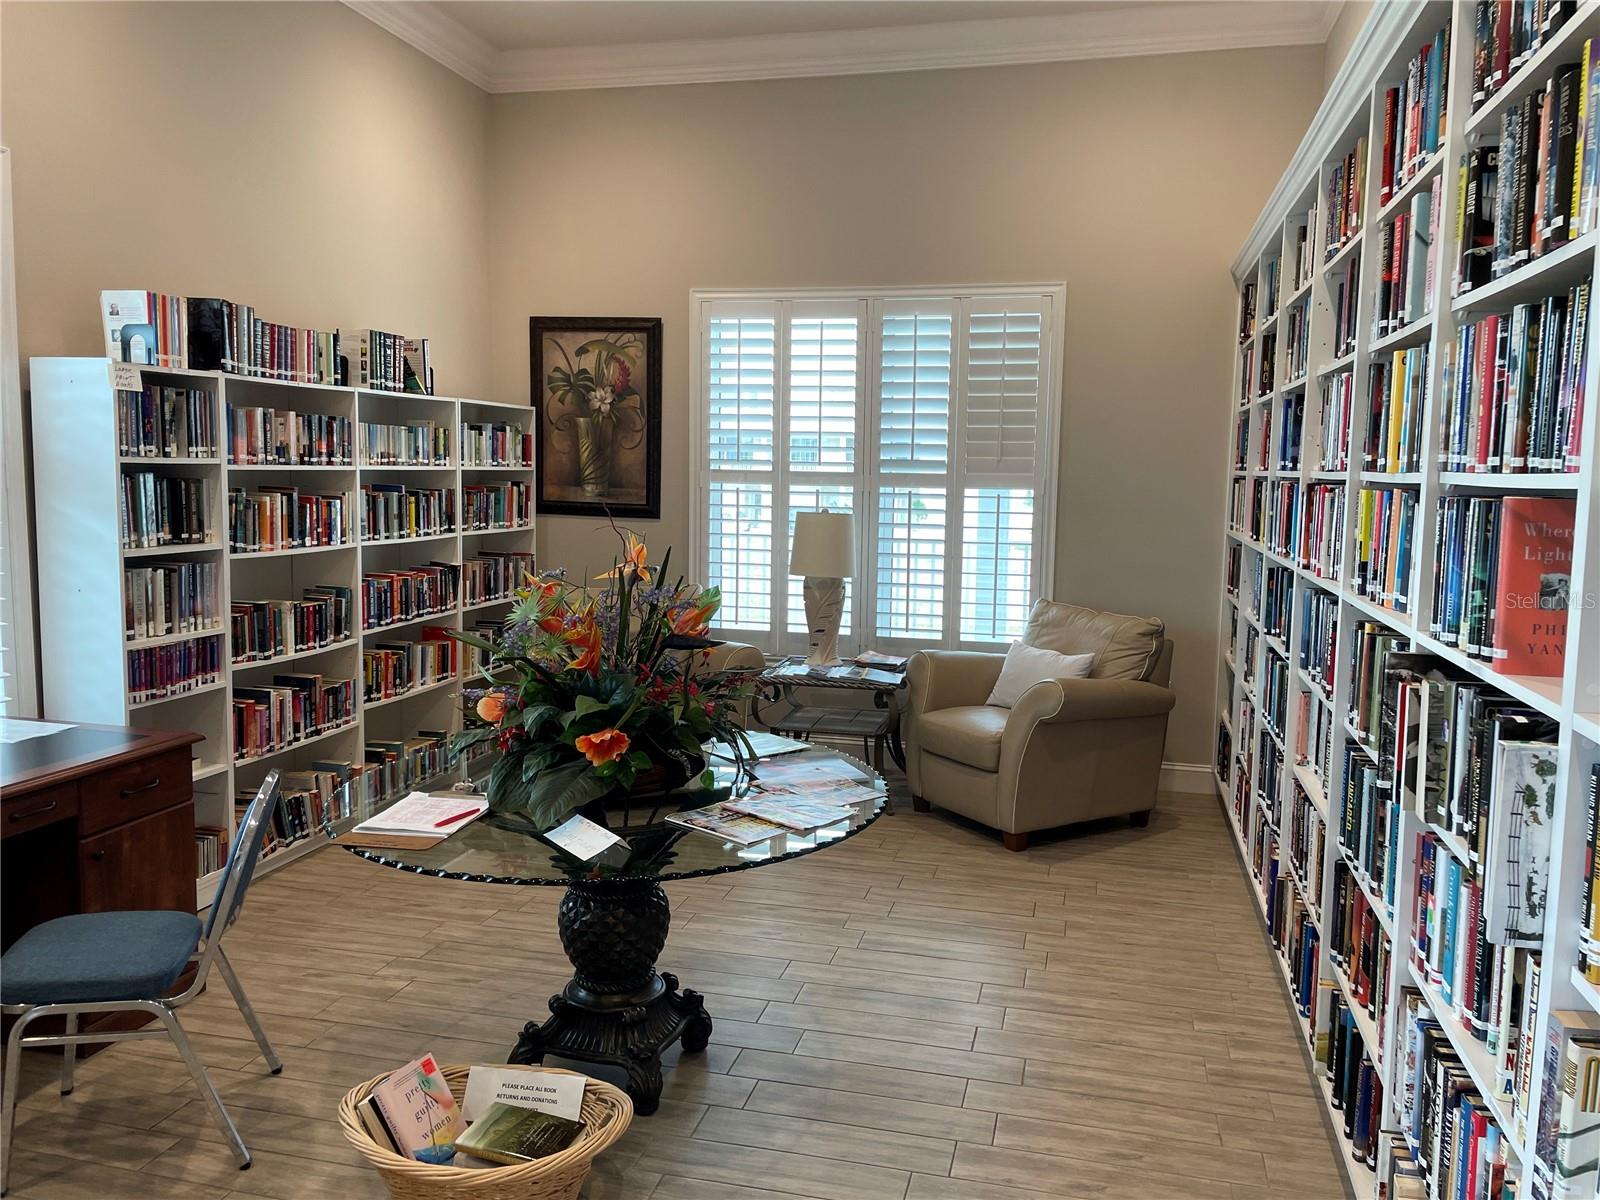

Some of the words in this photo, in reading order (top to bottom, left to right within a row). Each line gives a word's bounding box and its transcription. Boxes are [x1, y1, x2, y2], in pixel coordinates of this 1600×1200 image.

[1466, 180, 1477, 215] WILDCAT
[1515, 212, 1524, 246] GUILTY
[1524, 522, 1575, 538] Wher
[1346, 780, 1354, 830] UNCAGED
[1588, 775, 1597, 807] KILLING
[1586, 808, 1595, 842] REAGAN
[1446, 865, 1456, 928] Cronkite
[1475, 933, 1483, 972] KURALT
[1530, 971, 1540, 998] Andrew
[404, 1078, 431, 1103] pretty
[496, 1093, 519, 1101] RETURNS
[531, 1096, 558, 1105] DONATIONS
[501, 1082, 520, 1090] PLEASE
[414, 1099, 440, 1123] guilty
[421, 1114, 452, 1140] women
[1443, 1109, 1453, 1166] MAESTRO
